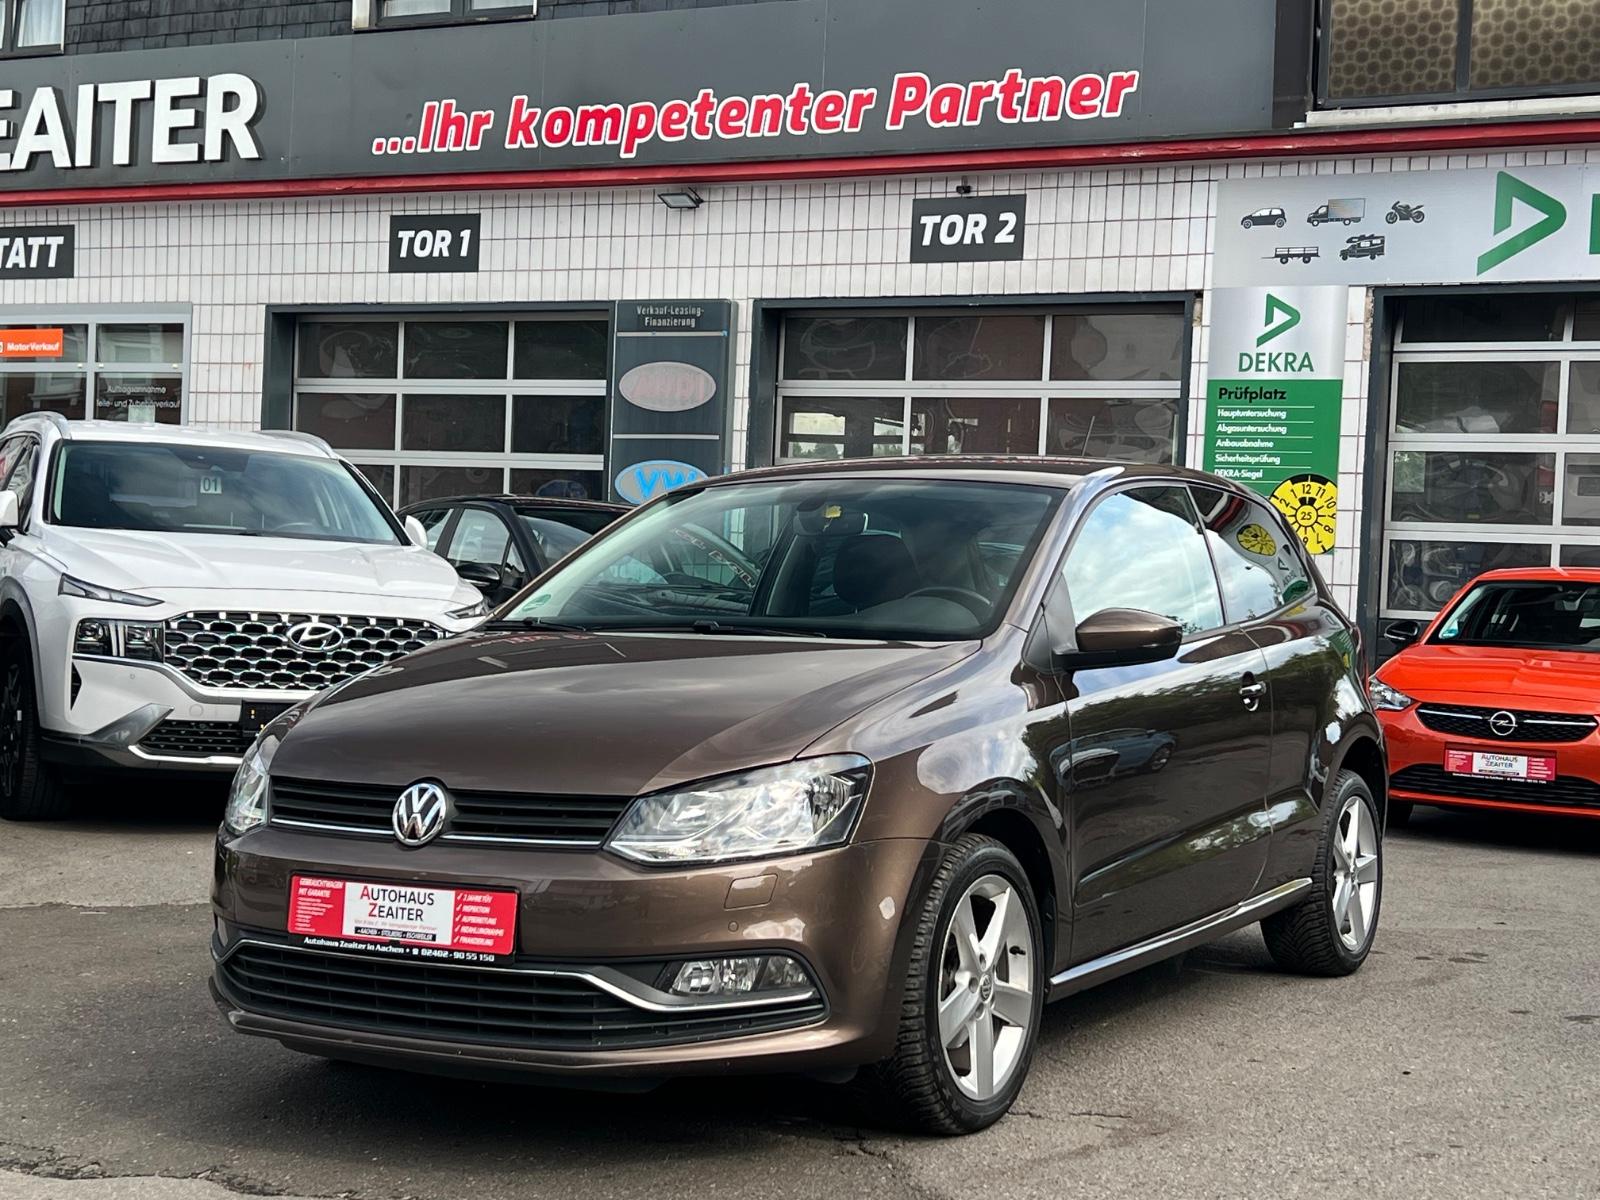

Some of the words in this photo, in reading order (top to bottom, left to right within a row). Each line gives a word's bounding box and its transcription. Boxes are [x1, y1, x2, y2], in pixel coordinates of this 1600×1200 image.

[372, 99, 494, 155] ...Ihr
[505, 82, 877, 158] kompetenter
[886, 68, 1139, 130] Partner
[919, 213, 987, 246] TOR
[994, 212, 1017, 244] 2
[398, 229, 452, 258] TOR
[460, 229, 472, 257] 1
[644, 317, 696, 328] Finanzierung
[1238, 352, 1315, 372] DEKRA
[1218, 386, 1287, 403] Prüfplatz
[114, 400, 128, 408] und
[1217, 409, 1287, 419] Hauptuntersuchung
[1216, 424, 1287, 434] Abgasuntersuchung
[1215, 439, 1274, 448] Anbauabnahme
[1214, 454, 1280, 465] Sicherheitsprüfung
[203, 477, 218, 491] 01
[1302, 484, 1312, 494] 12
[1300, 512, 1312, 520] 25
[360, 886, 434, 906] AUTOHAUS
[368, 903, 423, 922] ZEAITER
[303, 937, 339, 947] Autohaus
[340, 940, 366, 950] Zeaiter
[367, 943, 375, 951] in
[375, 944, 404, 953] Aachen
